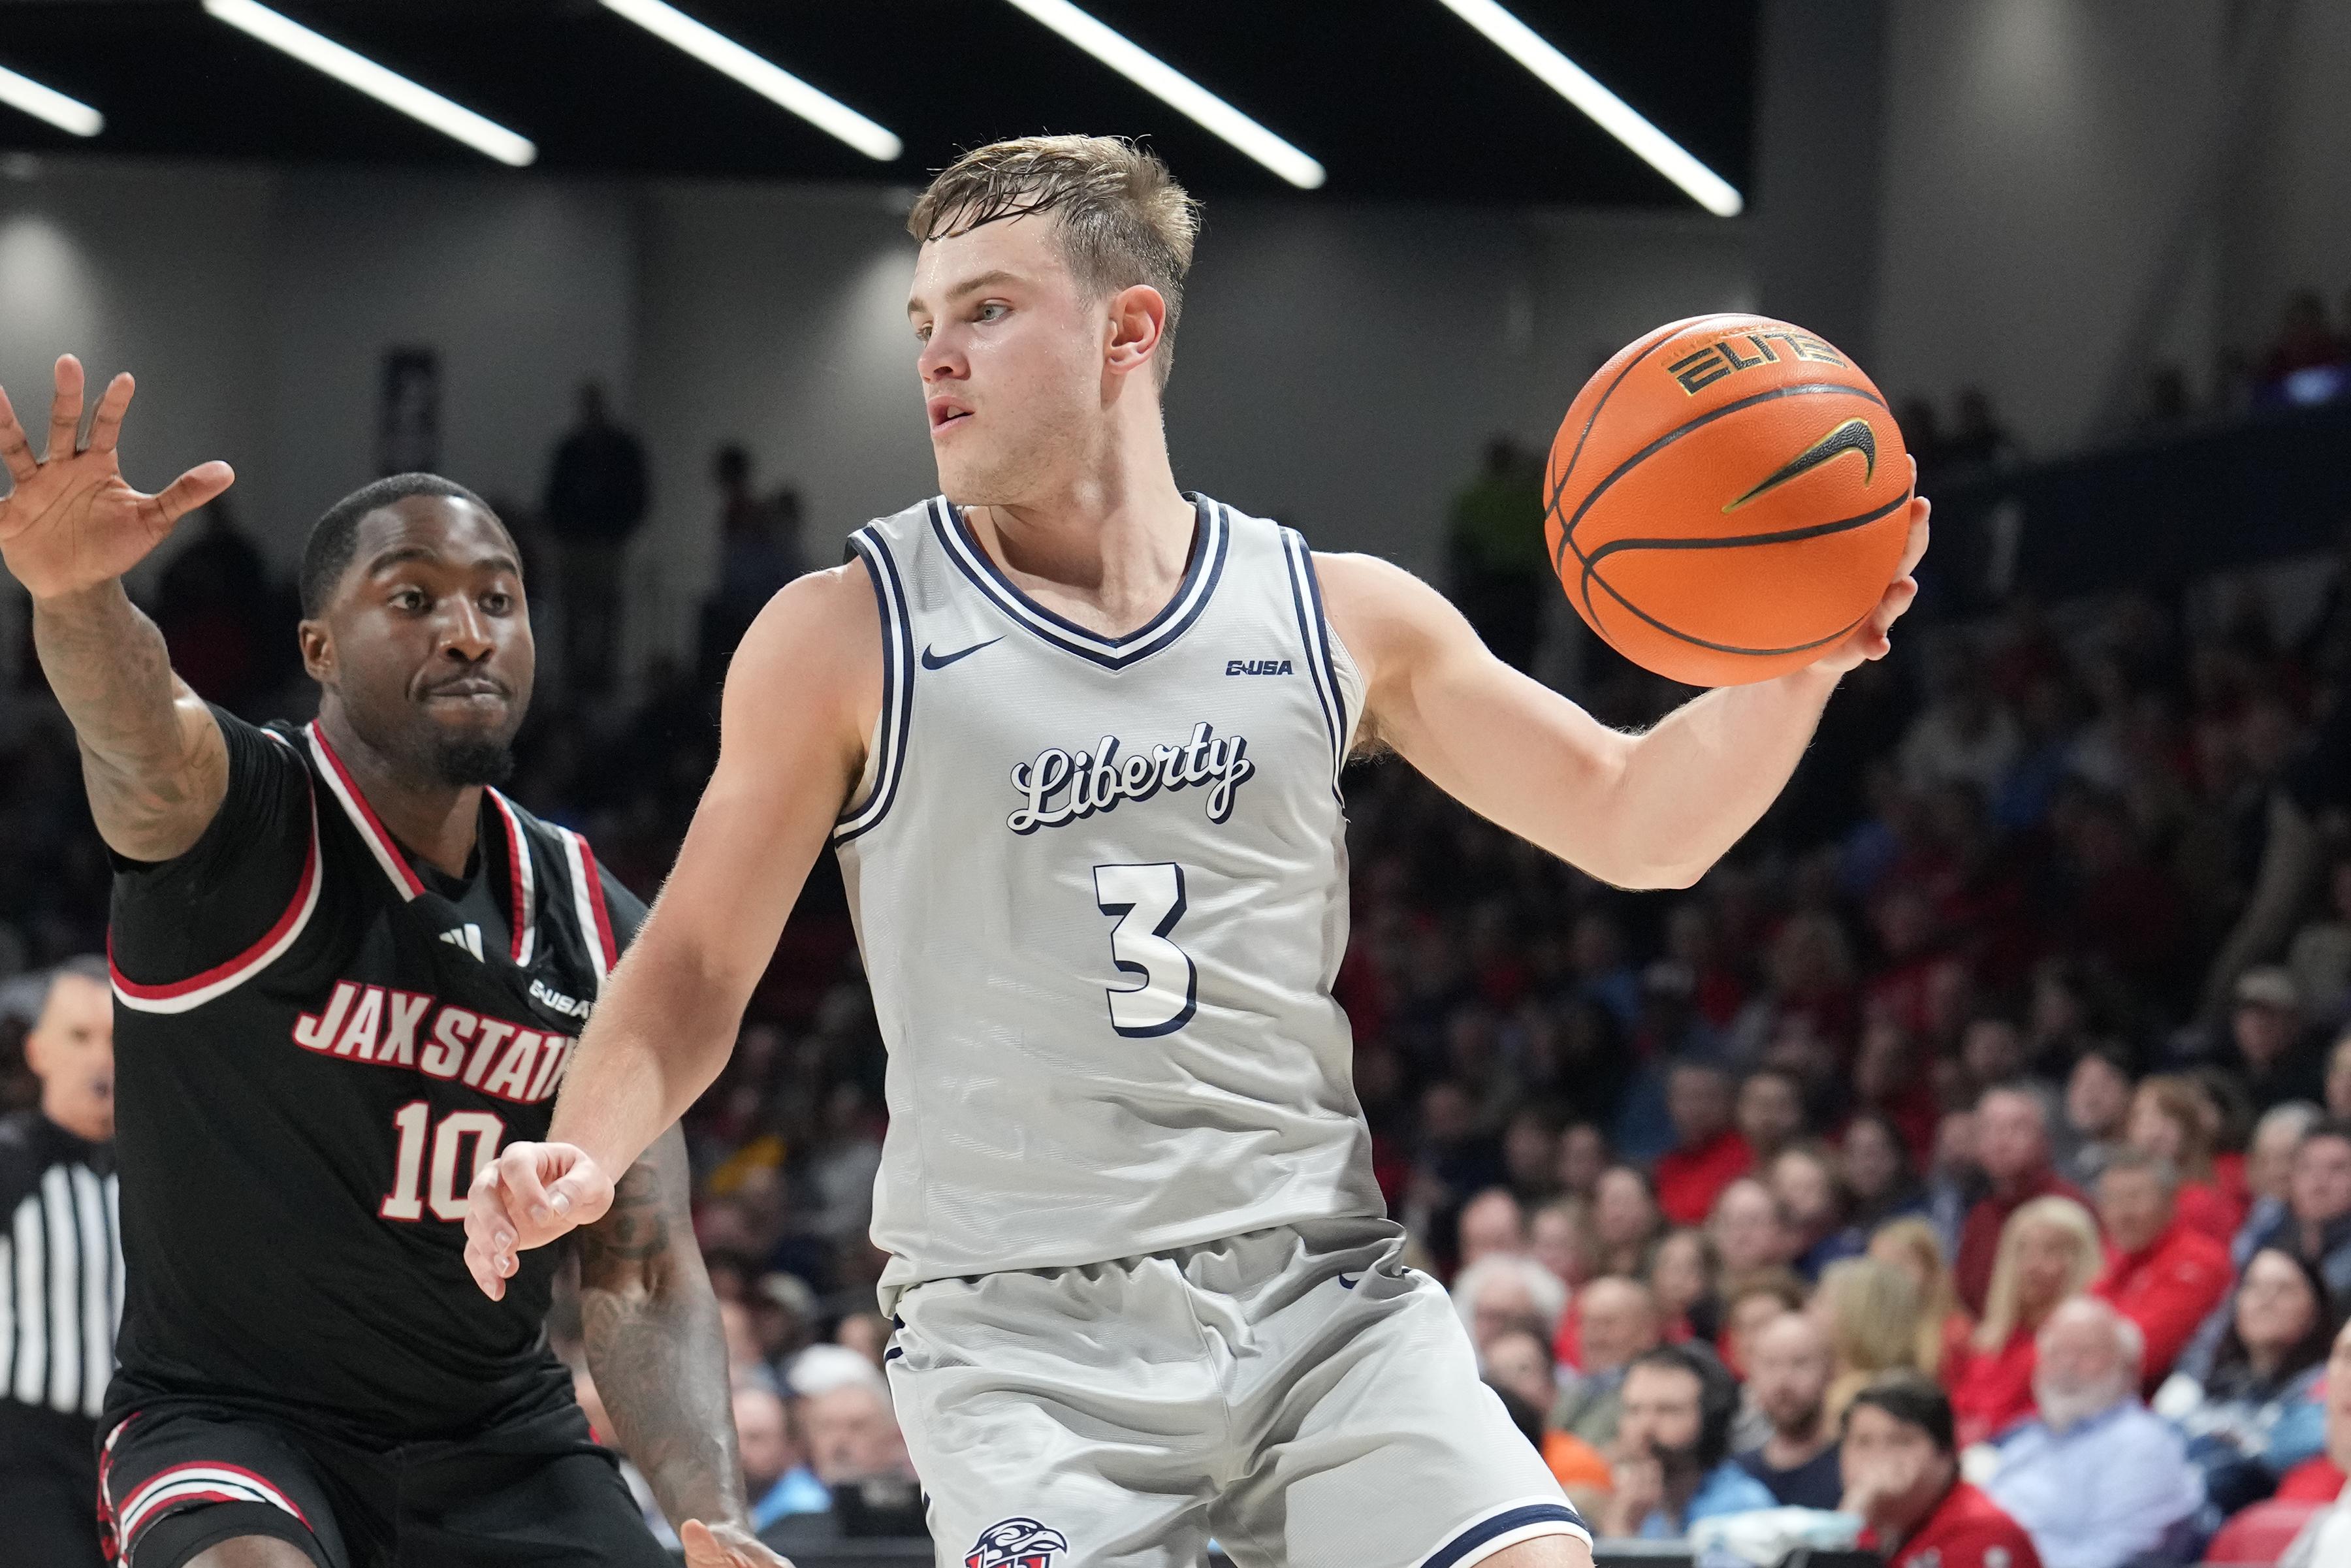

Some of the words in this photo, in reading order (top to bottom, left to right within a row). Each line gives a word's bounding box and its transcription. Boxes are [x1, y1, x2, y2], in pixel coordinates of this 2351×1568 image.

[1667, 332, 1849, 396] ELITE
[1006, 722, 1255, 836] Liberty
[1093, 862, 1197, 1038] 3
[293, 980, 434, 1068] JAX
[379, 1100, 505, 1221] 10
